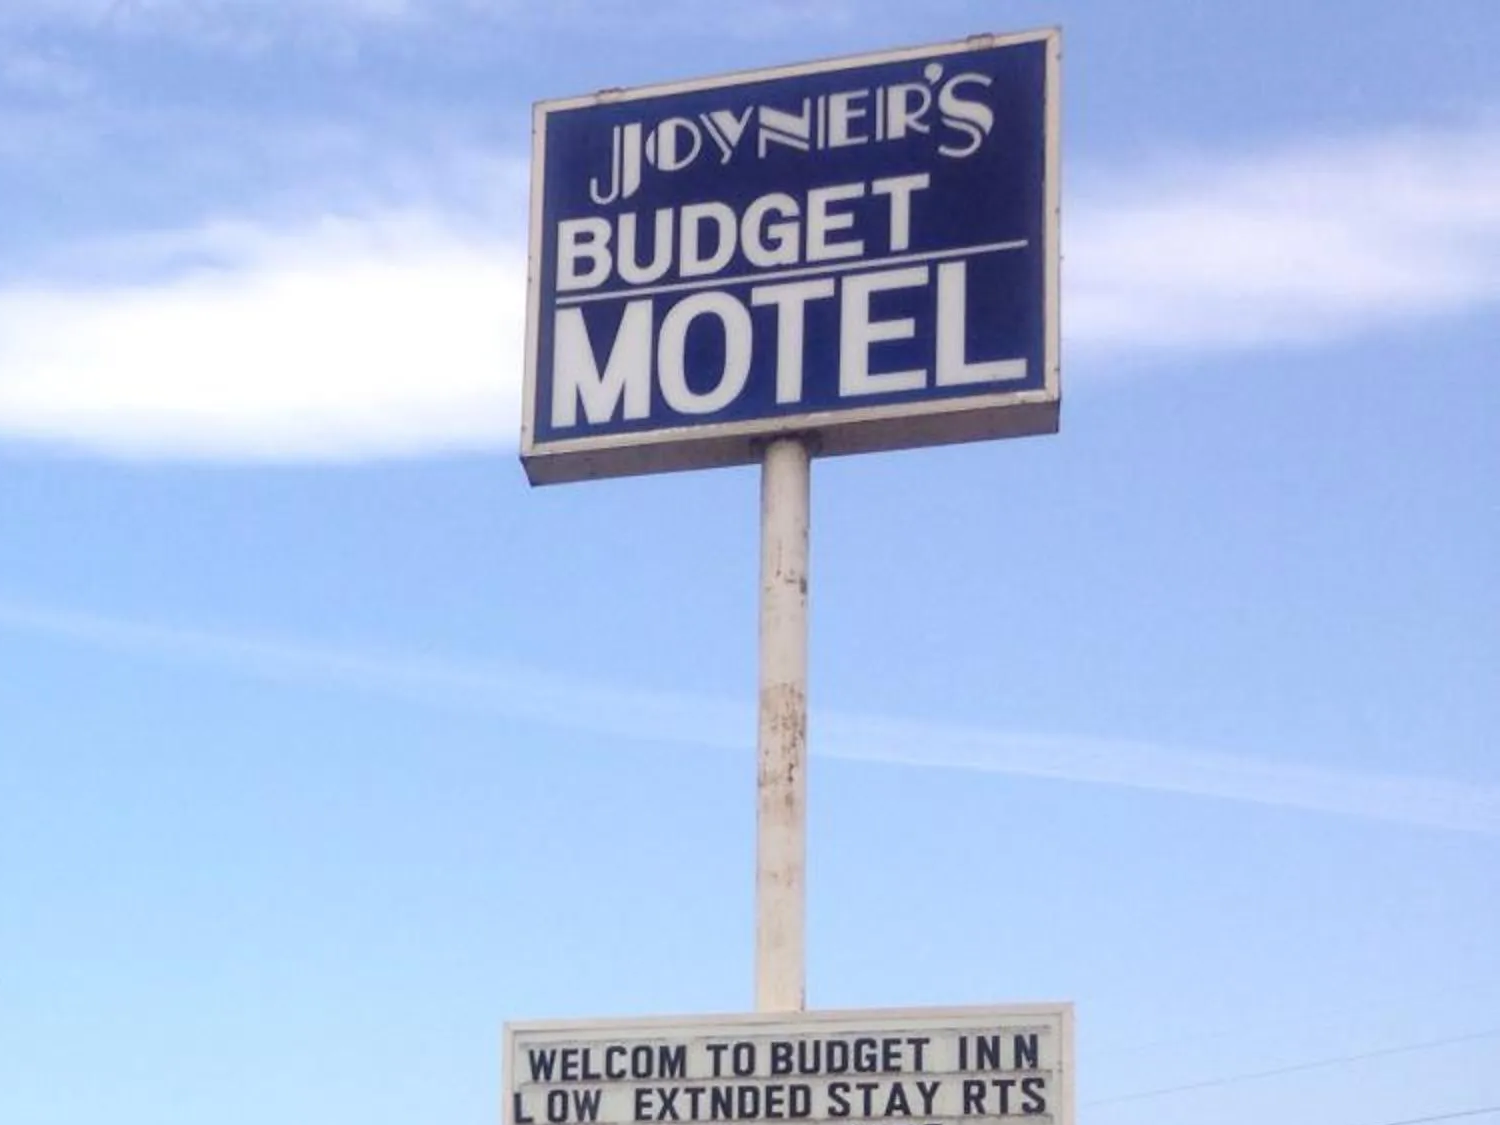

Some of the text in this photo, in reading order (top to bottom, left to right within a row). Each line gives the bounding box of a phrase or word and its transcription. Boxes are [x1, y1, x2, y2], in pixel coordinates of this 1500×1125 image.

[589, 62, 995, 206] JOYNER'S
[555, 172, 931, 293] BUDGET
[550, 259, 1028, 430] MOTEL
[512, 1077, 1047, 1125] LOW EXTNDED STAY RTS
[528, 1033, 1039, 1083] WELCOM TO BUDGET INN
